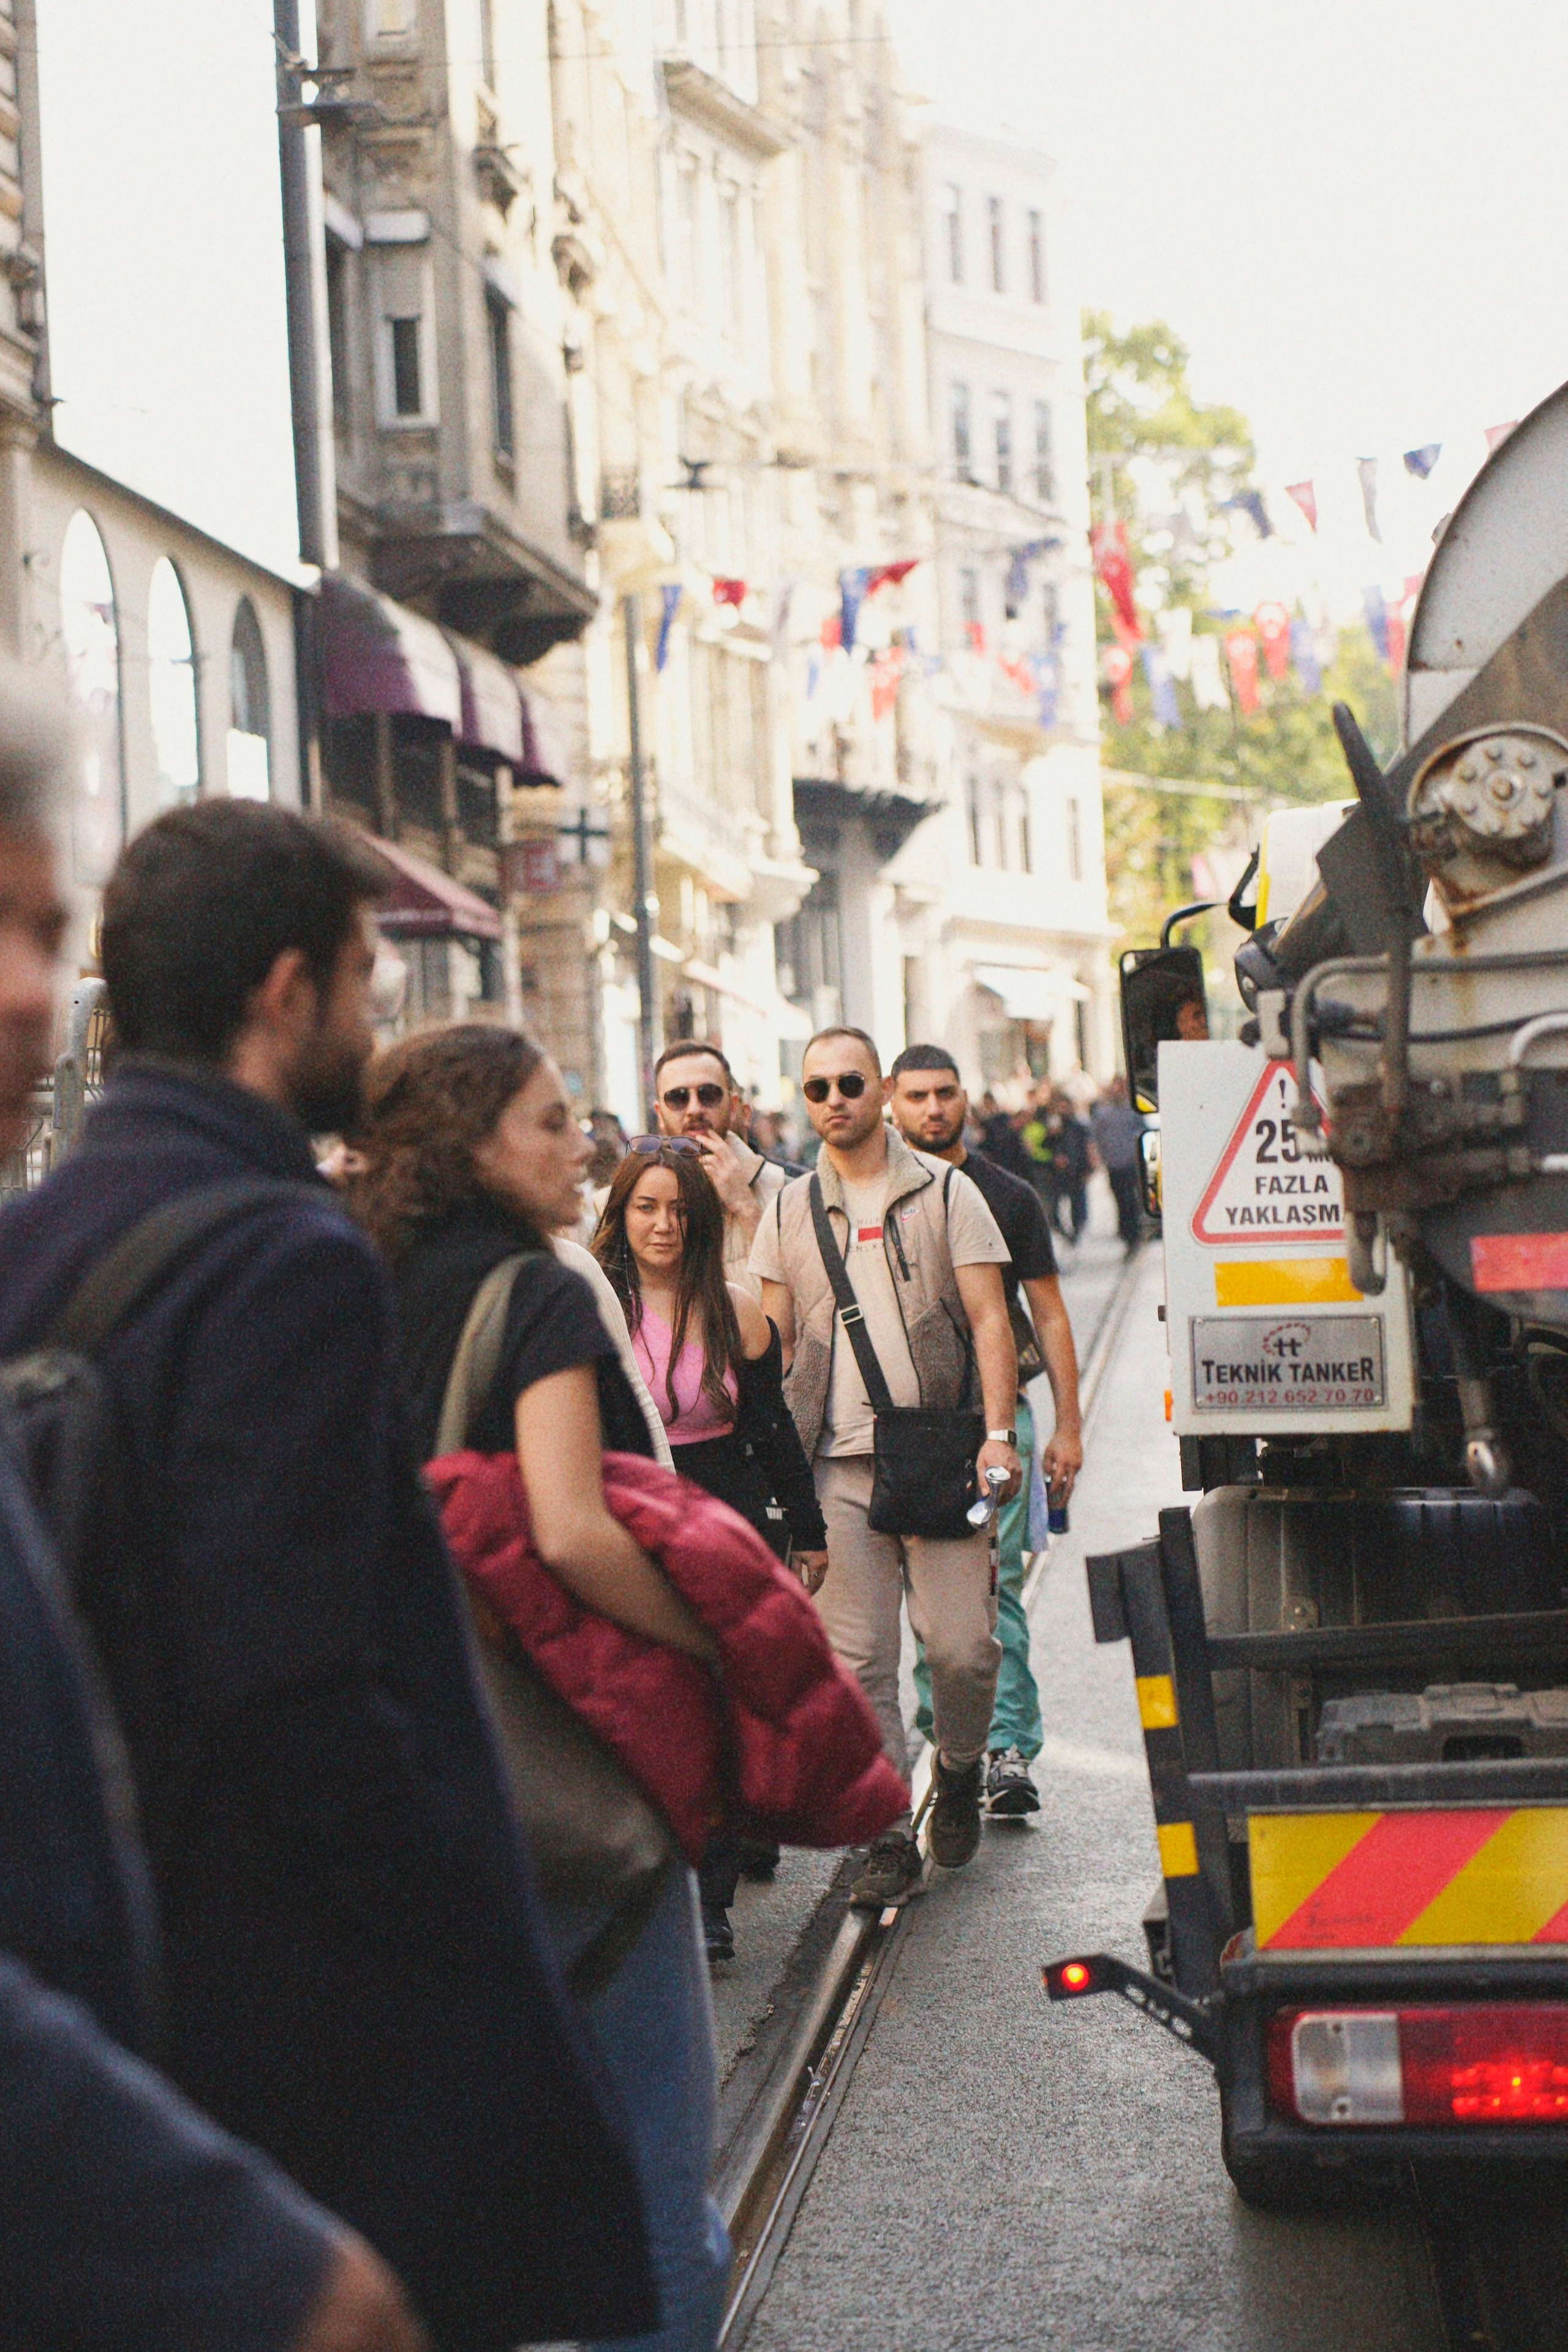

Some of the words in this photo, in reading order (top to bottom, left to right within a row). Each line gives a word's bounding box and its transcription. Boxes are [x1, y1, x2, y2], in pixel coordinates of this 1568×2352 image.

[1256, 1119, 1301, 1163] 25
[1256, 1174, 1329, 1194] FAZLA
[1225, 1204, 1343, 1226] YAKLAŞM
[1201, 1358, 1282, 1384] TEKNİK
[1288, 1357, 1374, 1383] TANKER
